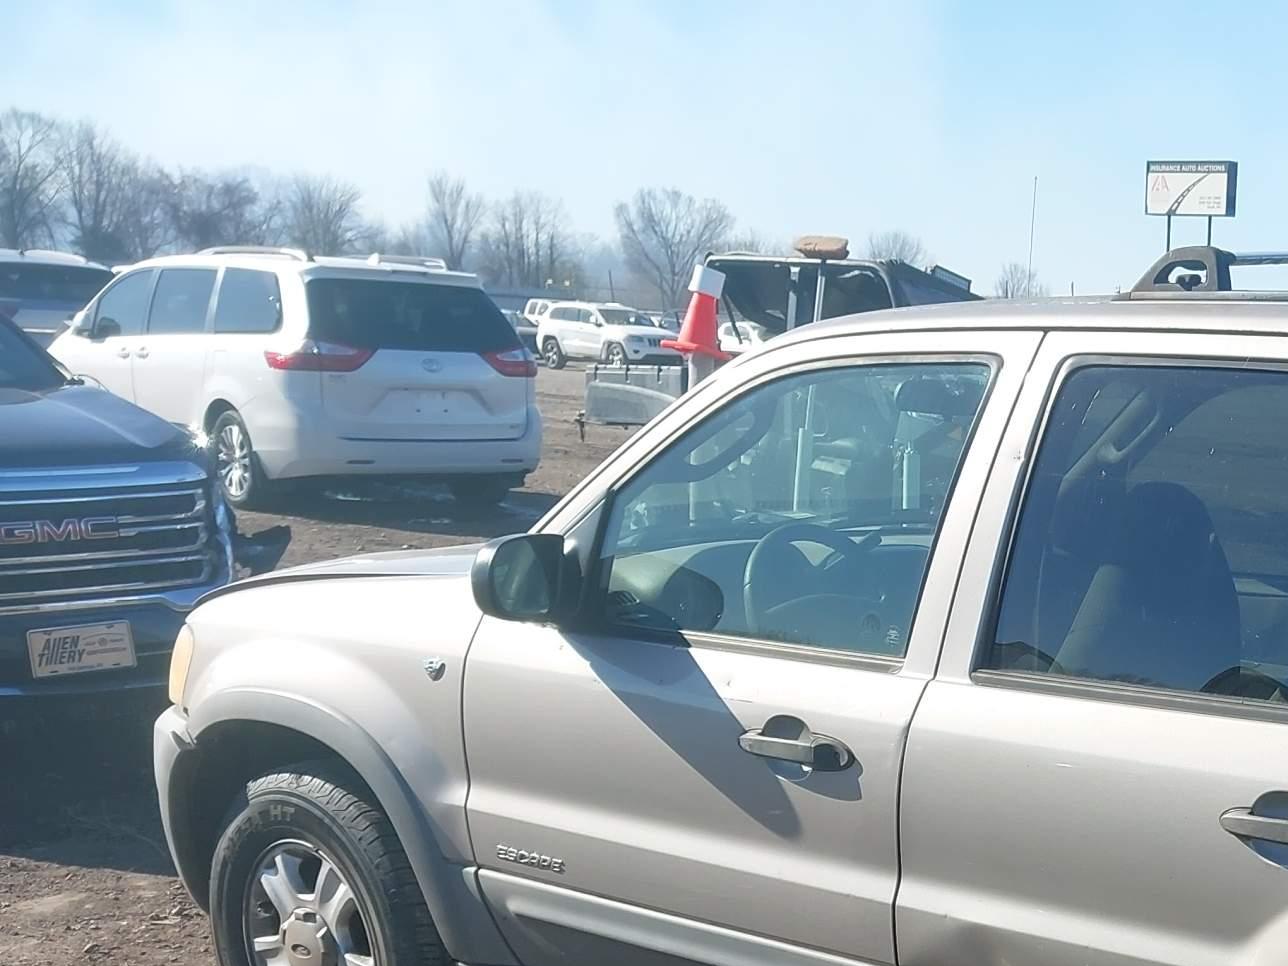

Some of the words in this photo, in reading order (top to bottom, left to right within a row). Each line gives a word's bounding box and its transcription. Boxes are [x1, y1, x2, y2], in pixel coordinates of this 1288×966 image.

[1150, 164, 1180, 172] INSURANCE
[1182, 164, 1196, 172] AUTO
[1197, 164, 1226, 172] AUCTIONS
[0, 517, 118, 544] GMC
[496, 844, 566, 874] ESCAPE
